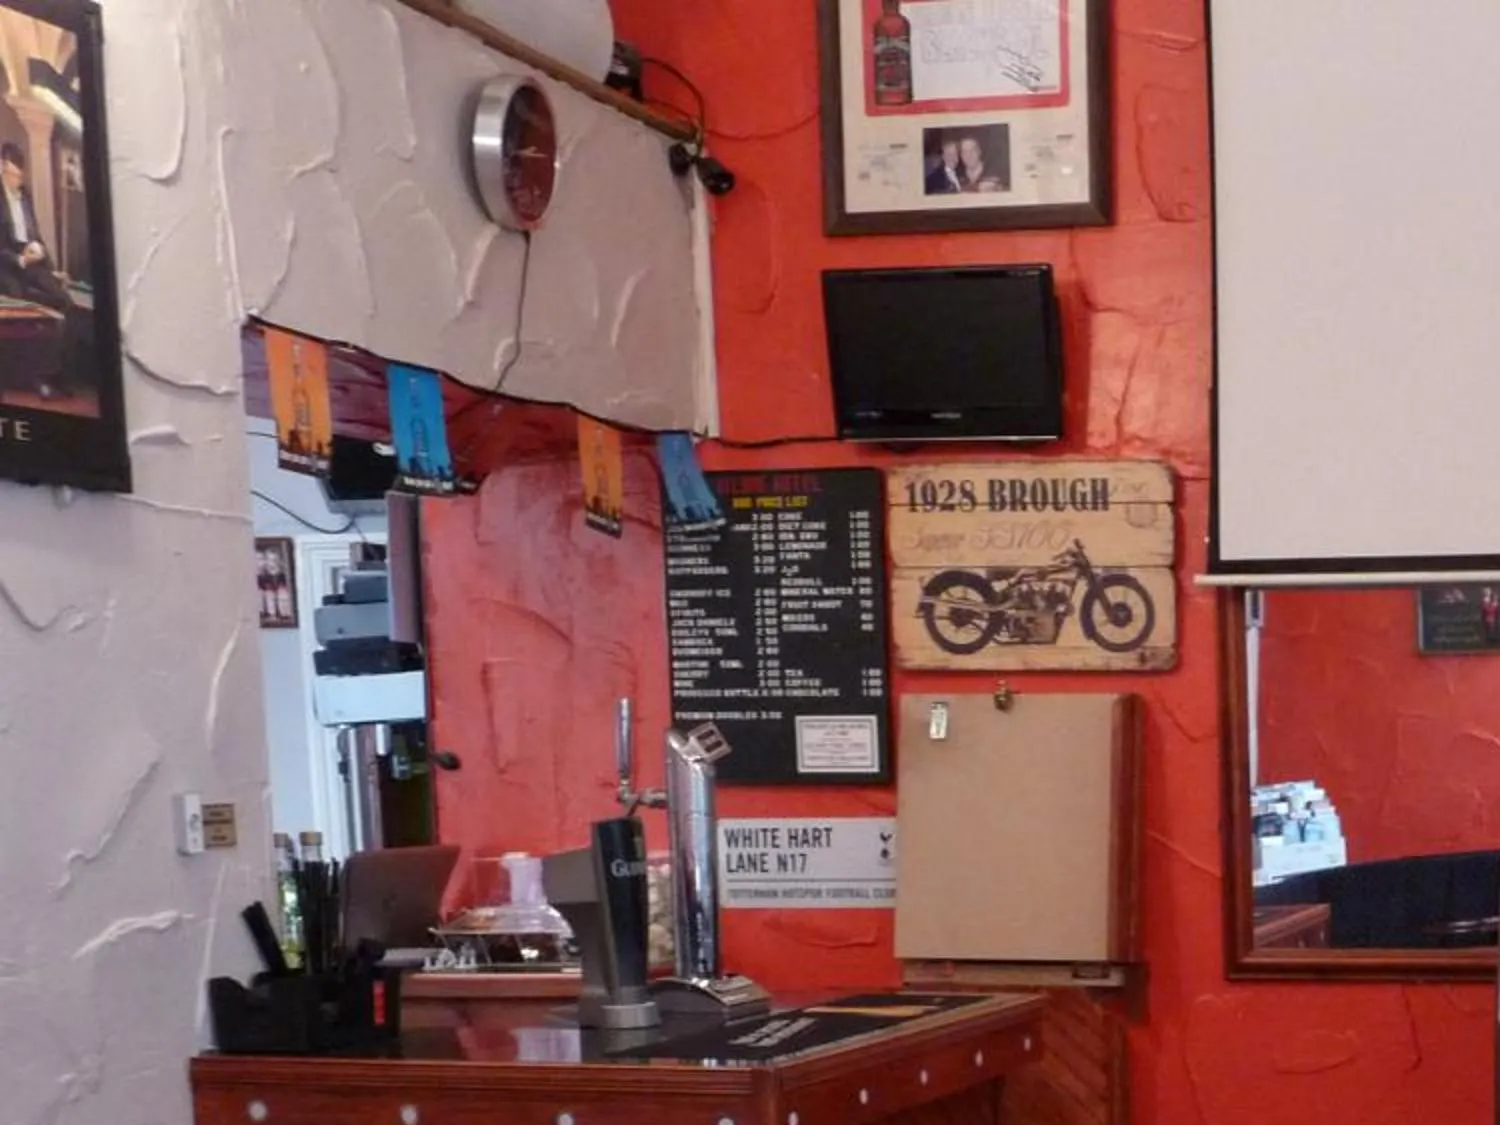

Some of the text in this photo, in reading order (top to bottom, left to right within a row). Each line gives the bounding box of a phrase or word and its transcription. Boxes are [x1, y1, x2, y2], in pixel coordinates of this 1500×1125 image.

[905, 478, 978, 513] 1928
[987, 477, 1110, 512] BROUGH
[724, 827, 833, 849] WHITE HART
[726, 853, 808, 874] LANE N17
